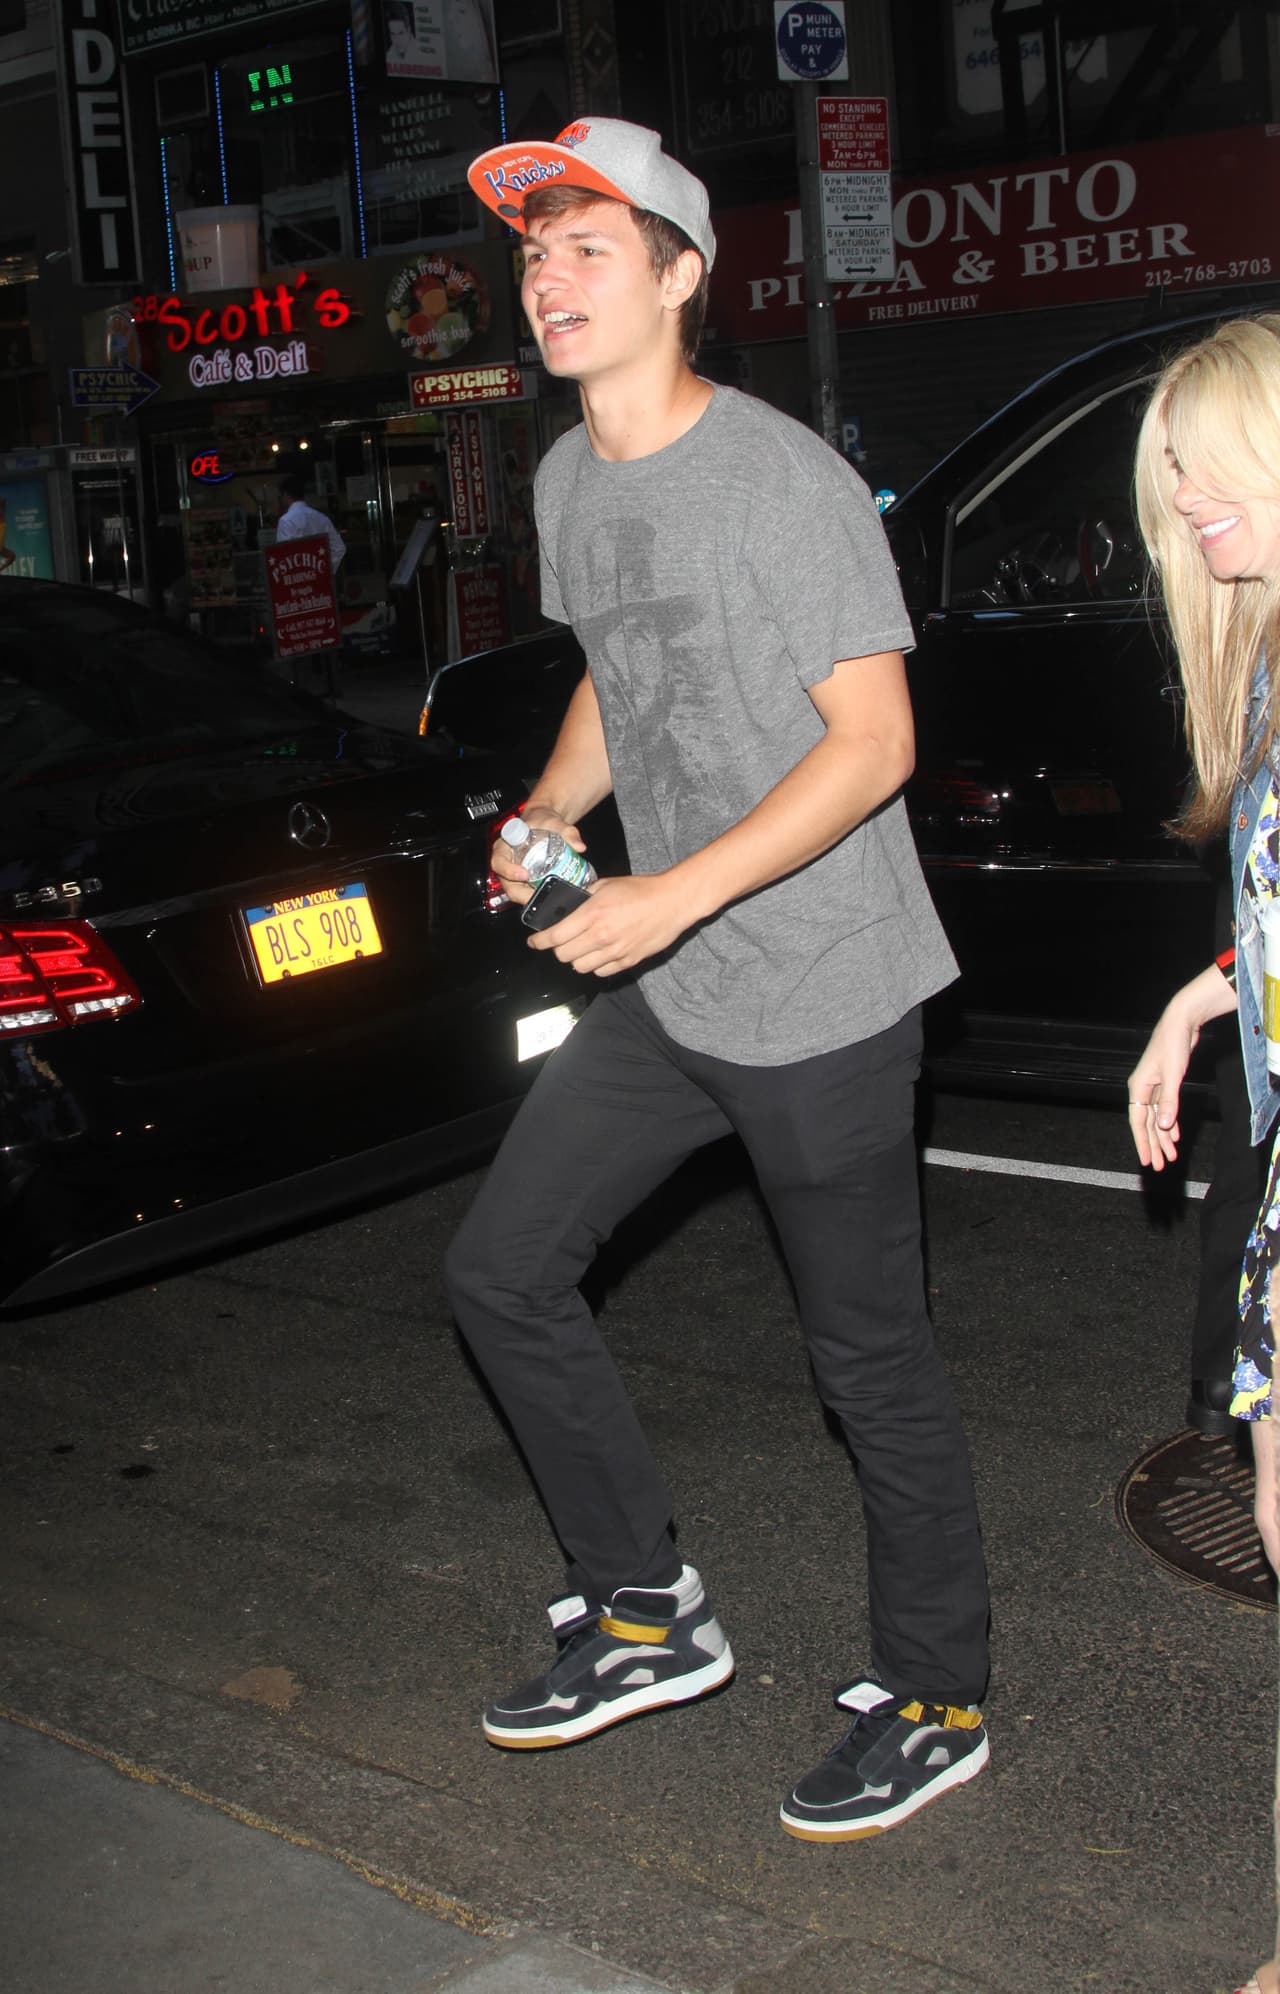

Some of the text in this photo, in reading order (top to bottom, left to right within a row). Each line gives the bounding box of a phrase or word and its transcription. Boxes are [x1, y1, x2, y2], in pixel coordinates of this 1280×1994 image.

[788, 14, 804, 37] P
[806, 14, 832, 25] MUNI
[807, 27, 842, 38] METER
[801, 45, 821, 55] PAY
[823, 103, 881, 113] NO STANDING
[839, 114, 865, 122] EXCEPT
[822, 131, 885, 140] METERED PARKING
[72, 29, 128, 271] DELI
[832, 149, 876, 159] 7AM-6PM
[827, 160, 848, 168] MON
[867, 160, 882, 168] FRI
[483, 159, 566, 200] Knicks
[826, 195, 888, 203] METERED PARKING
[829, 186, 849, 194] MON
[869, 186, 884, 194] FRI
[828, 247, 891, 256] METERED PARKING
[834, 239, 881, 247] SATURDAY
[952, 250, 996, 285] &
[1019, 222, 1196, 278] BEER
[417, 257, 446, 277] fresh
[1145, 257, 1272, 288] 212-768-3703
[157, 270, 351, 352] Scott's
[868, 294, 981, 321] FREE DELIVERY
[189, 340, 310, 388] Café & Deli
[79, 372, 138, 386] PSYCHIC
[423, 368, 510, 393] PSYCHIC
[452, 386, 508, 402] 354-5108
[75, 453, 97, 462] FREE
[469, 420, 486, 528] PSYCHIC
[272, 552, 326, 584] PSYCHIC
[15, 876, 102, 909] E350
[273, 888, 339, 916] NEW YORK
[265, 905, 363, 965] BLS 908
